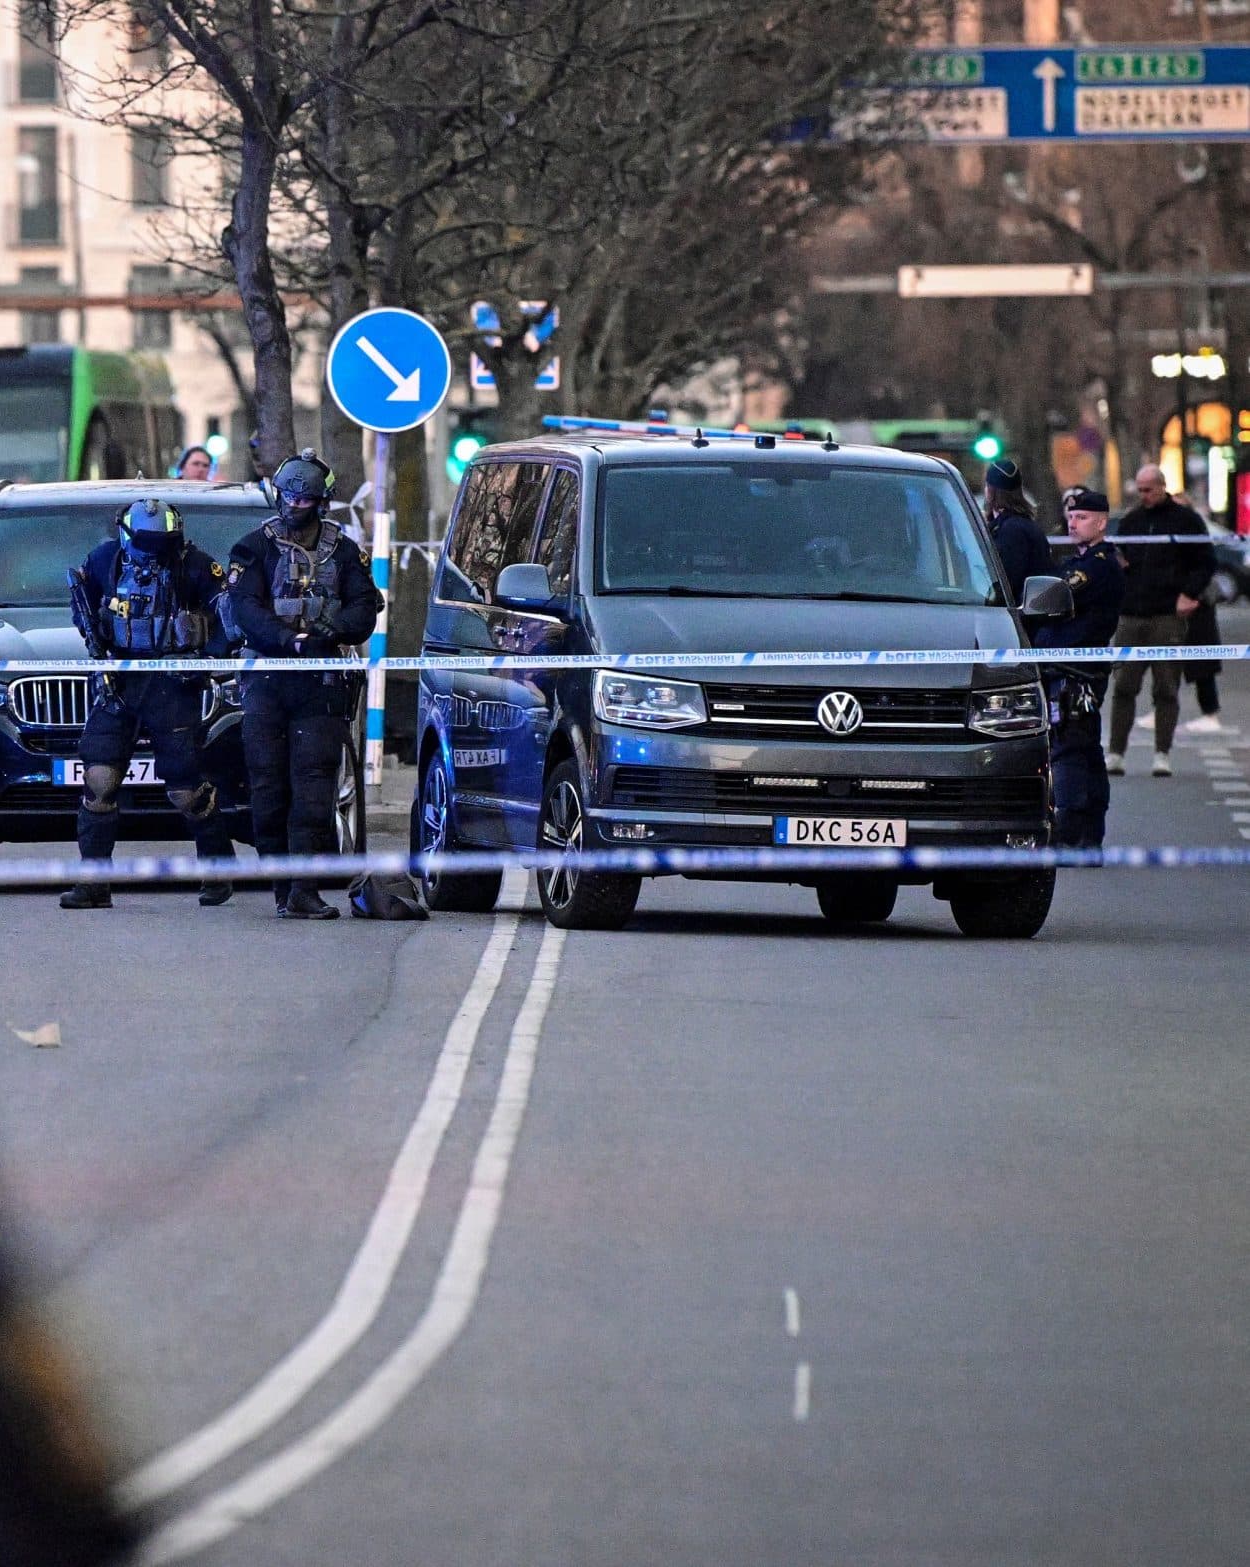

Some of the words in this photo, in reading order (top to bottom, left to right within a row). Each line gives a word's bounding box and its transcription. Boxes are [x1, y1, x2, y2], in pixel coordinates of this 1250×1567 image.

[1083, 90, 1244, 109] NOBELTORGET
[796, 820, 842, 841] DKC
[850, 821, 896, 843] 56A
